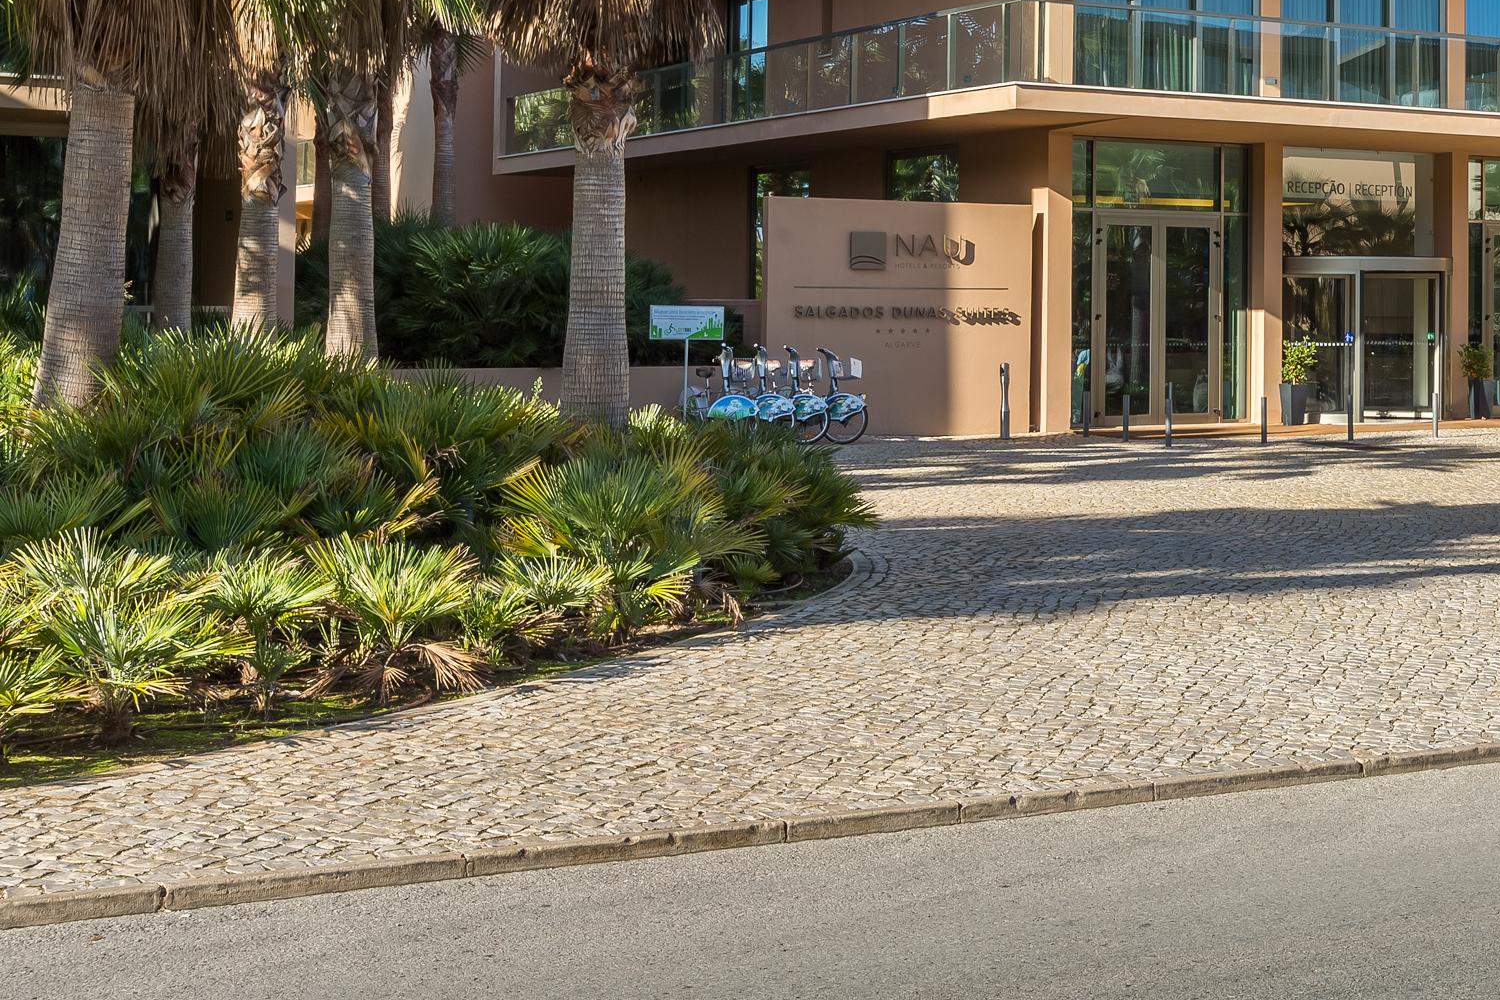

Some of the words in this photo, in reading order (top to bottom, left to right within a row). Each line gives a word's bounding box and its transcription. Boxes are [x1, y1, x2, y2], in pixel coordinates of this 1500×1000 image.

[1287, 180, 1345, 196] RECEPÇÃO
[1355, 184, 1413, 198] RECEPTION
[895, 233, 961, 257] NAU
[794, 305, 884, 319] SALGADOS
[891, 306, 947, 319] DUNAS
[955, 306, 1011, 320] SUITES
[885, 341, 921, 349] ALGARVE
